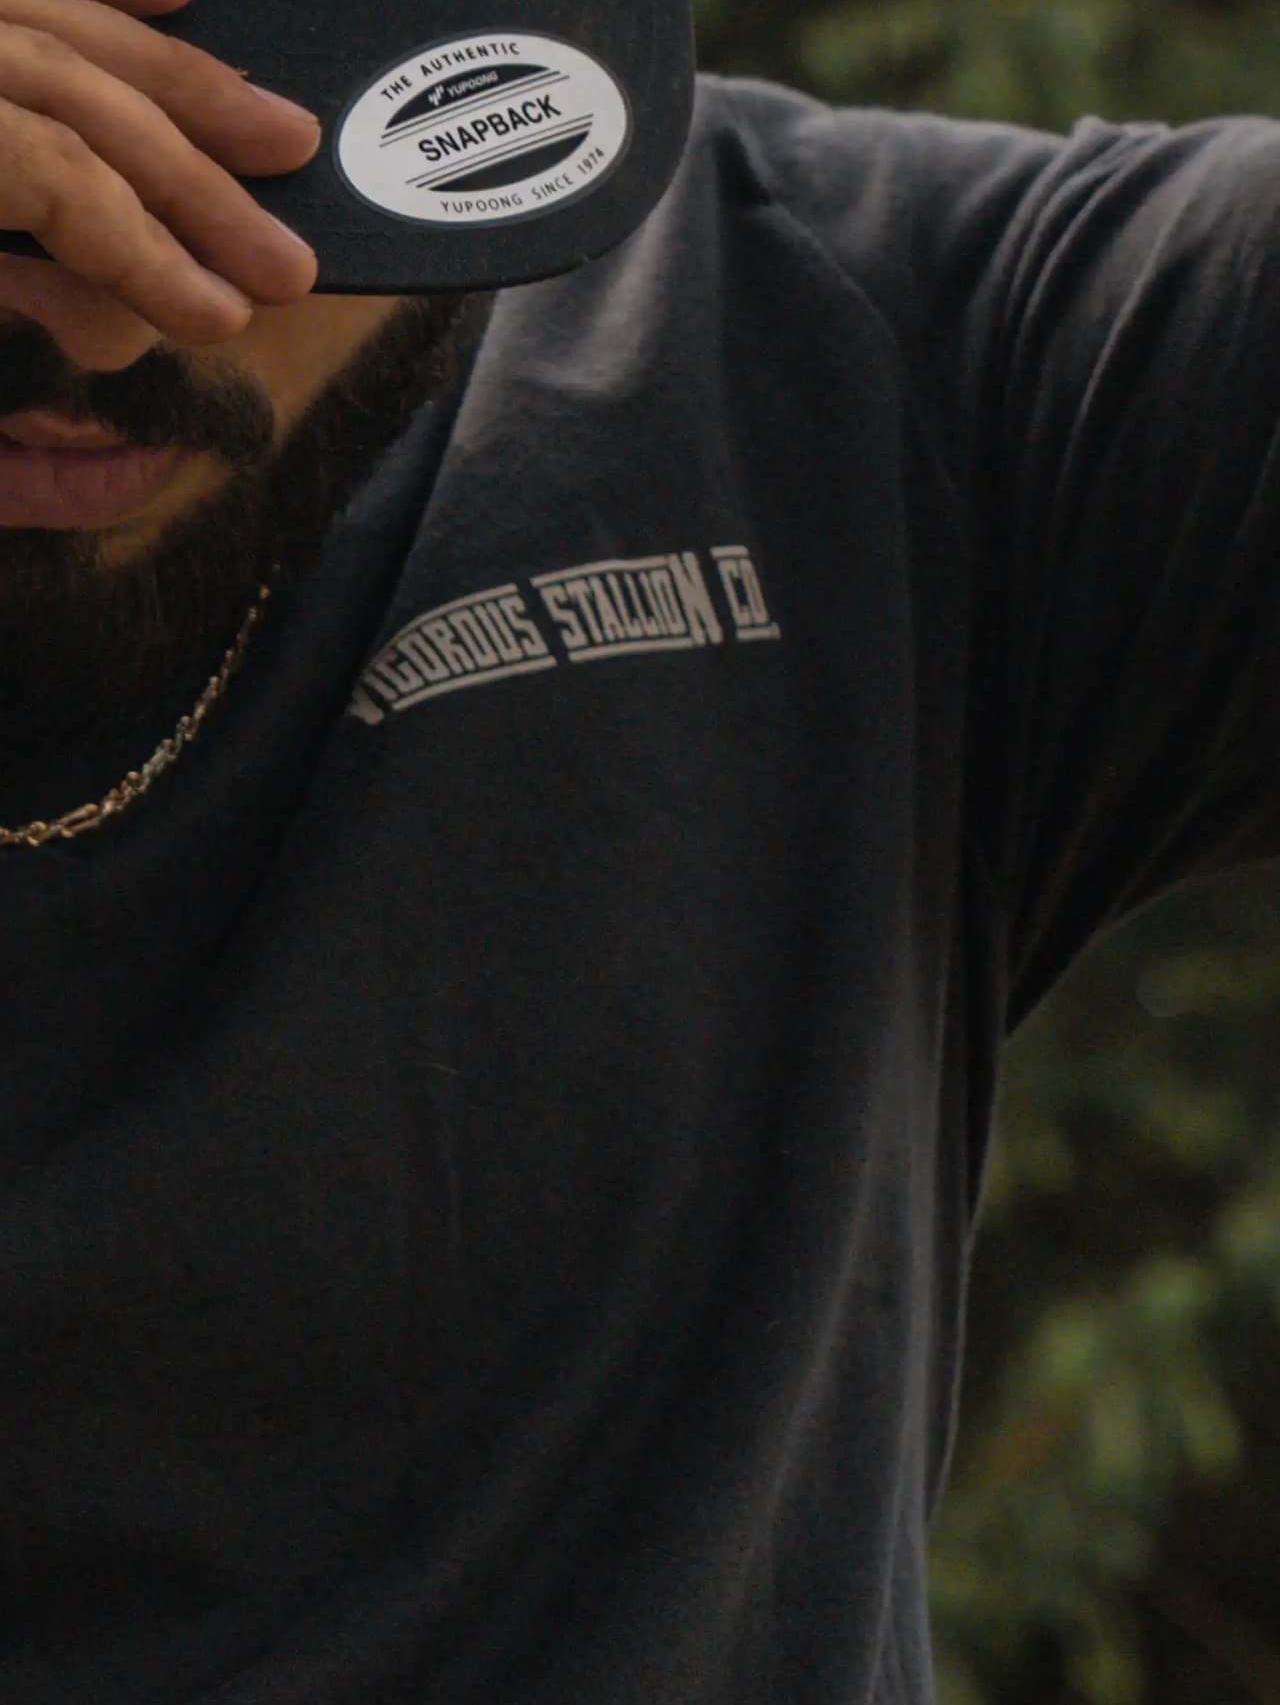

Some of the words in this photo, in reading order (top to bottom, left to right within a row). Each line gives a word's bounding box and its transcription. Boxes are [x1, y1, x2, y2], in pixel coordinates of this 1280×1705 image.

[380, 75, 413, 101] THE
[420, 43, 521, 76] AUTHENTIC
[446, 71, 499, 98] YUPOONG
[418, 95, 562, 162] SNAPBACK
[441, 194, 523, 214] YUPOONG
[531, 172, 573, 200] SINCE
[577, 148, 605, 175] 1974
[540, 551, 722, 647] STALLION
